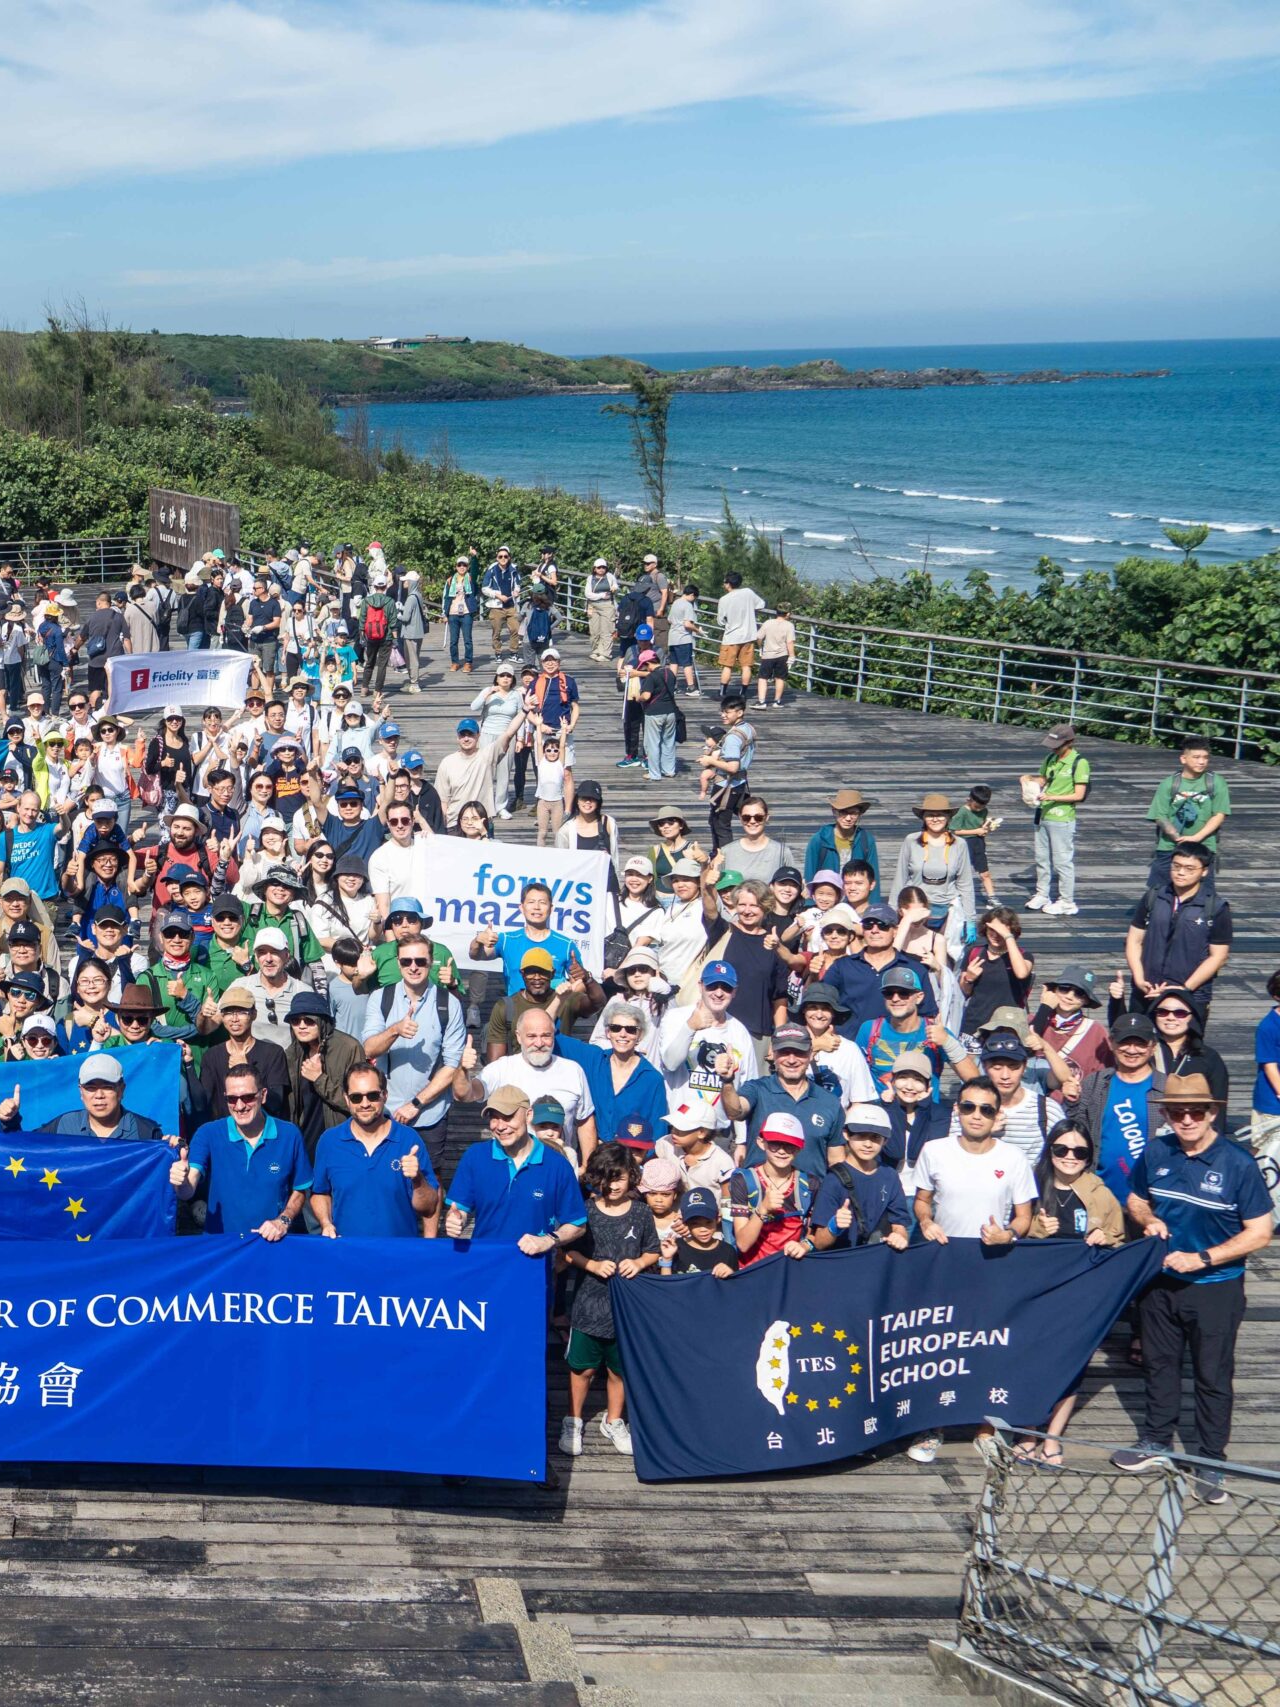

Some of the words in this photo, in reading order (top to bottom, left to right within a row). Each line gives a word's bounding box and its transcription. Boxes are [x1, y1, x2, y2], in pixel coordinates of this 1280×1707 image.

[152, 670, 193, 682] Fidelity
[197, 669, 220, 680] 富達
[435, 897, 591, 934] mazrs
[690, 1072, 723, 1089] BEAR
[27, 1299, 77, 1328] OF
[86, 1291, 314, 1328] COMMERCE
[326, 1291, 488, 1331] TAIWAN
[880, 1305, 954, 1333] TAIPEI
[880, 1328, 1010, 1364] EUROPEAN
[796, 1356, 837, 1373] TES
[880, 1357, 971, 1393] SCHOOL
[766, 1387, 1009, 1450] 台北歐洲學校
